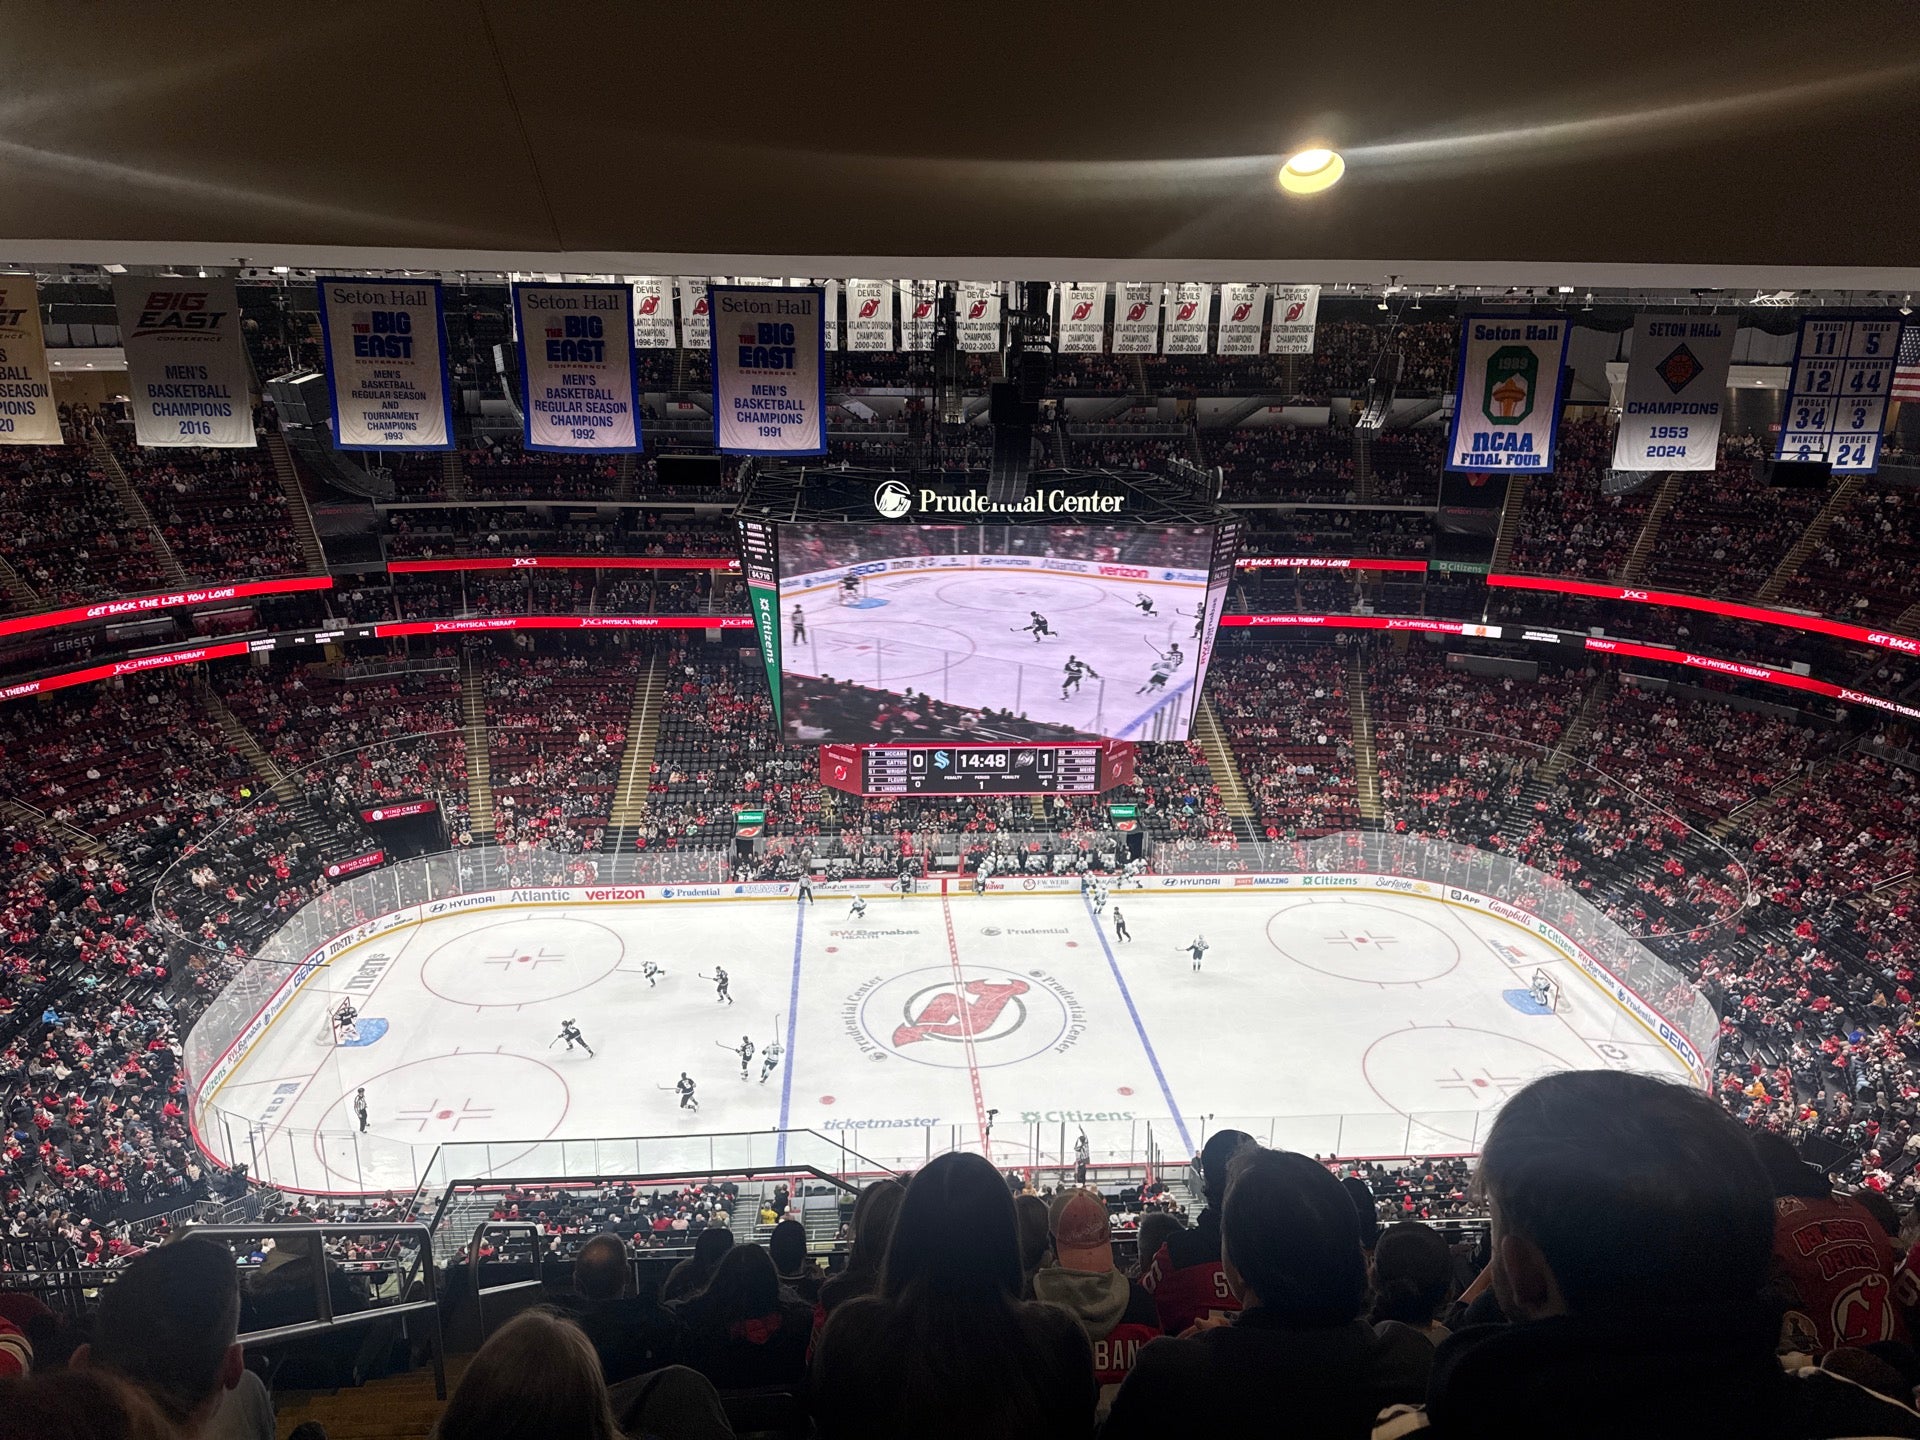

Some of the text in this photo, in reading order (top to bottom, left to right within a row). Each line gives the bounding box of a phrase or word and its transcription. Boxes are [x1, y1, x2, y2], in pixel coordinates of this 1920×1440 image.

[636, 286, 660, 294] DEVILS
[857, 289, 881, 297] DEVILS
[1072, 292, 1095, 300] DEVILS
[1127, 292, 1150, 300] DEVILS
[1178, 292, 1200, 300] DEVILS
[145, 293, 208, 310] BIG
[333, 288, 428, 305] Seton Hall
[527, 294, 619, 310] Seton Hall
[722, 297, 811, 315] Seton Hall
[137, 312, 226, 328] EAST
[372, 311, 412, 334] BIG
[849, 321, 871, 329] ATLANTIC
[545, 316, 604, 338] THE BIG
[637, 329, 666, 337] CHAMPIONS
[1061, 324, 1082, 332] ATLANTIC
[1115, 324, 1136, 332] ATLANTIC
[1167, 324, 1187, 332] ATLANTIC
[1221, 325, 1241, 333] ATLANTIC
[1475, 324, 1558, 340] Seton Hall
[1649, 323, 1721, 337] SETON HALL
[1813, 323, 1843, 331] DAVIES
[758, 322, 795, 345] BIG
[856, 332, 884, 340] CHAMPIONS
[964, 333, 991, 341] CHAMPIONS
[1068, 334, 1095, 342] CHAMPIONS
[1122, 334, 1149, 343] CHAMPIONS
[1172, 335, 1199, 343] CHAMPIONS
[1227, 335, 1252, 343] CHAMPIONS
[1276, 335, 1308, 343] CHAMPIONS
[353, 335, 412, 358] EAST
[635, 339, 669, 347] 1996-1997
[854, 341, 887, 349] 2000-2001
[960, 342, 996, 350] 2002-2003
[1118, 344, 1152, 352] 2006-2007
[1815, 333, 1836, 354] 11
[1866, 333, 1880, 354] 5
[546, 339, 605, 362] EAST
[739, 346, 796, 369] EAST
[166, 365, 208, 379] MEN'S
[374, 370, 401, 379] MEN'S
[361, 381, 415, 390] BASKETBALL
[562, 374, 596, 385] MEN'S
[1807, 371, 1832, 392] 12
[1850, 370, 1882, 392] 44
[148, 385, 231, 399] BASKETBALL
[352, 391, 426, 400] REGULAR SEASON
[546, 388, 614, 400] BASKETBALL
[752, 385, 787, 396] MEN'S
[382, 401, 399, 409] AND
[535, 400, 627, 413] REGULAR SEASON
[734, 397, 805, 411] BASKETBALL
[1627, 402, 1719, 414] CHAMPIONS
[1797, 399, 1830, 407] MOSLEY
[153, 403, 232, 417] CHAMPIONS
[363, 412, 420, 420] TOURNAMENT
[550, 415, 613, 427] CHAMPIONS
[737, 412, 803, 424] CHAMPIONS
[1795, 408, 1826, 429] 34
[1851, 408, 1866, 429] 3
[180, 421, 210, 434] 2016
[367, 422, 417, 430] CHAMPIONS
[758, 426, 781, 437] 1991
[384, 432, 404, 440] 1993
[571, 429, 595, 439] 1992
[1650, 427, 1689, 438] 1953
[1839, 436, 1872, 444] DEHERE
[1646, 446, 1686, 457] 2024
[1836, 444, 1866, 465] 24
[1506, 454, 1541, 466] FOUR
[1048, 489, 1125, 513] Center
[512, 557, 538, 567] JAG
[1041, 557, 1088, 573] Atlantic
[1251, 558, 1271, 566] BACK
[1290, 558, 1309, 566] LIFE
[1310, 559, 1326, 567] YOU
[1327, 559, 1350, 567] LOVE!
[1448, 563, 1482, 573] Citizens
[1098, 564, 1149, 579] verizon
[1620, 589, 1648, 600] JAG
[86, 588, 235, 617] GET BACK THE LIFE YOU LOVE!
[456, 619, 517, 628] PHYSICAL THERAPY
[1408, 620, 1437, 629] PHYSICAL
[52, 634, 96, 653] JERSEY
[761, 612, 774, 664] Citizens
[1867, 633, 1916, 651] GET BACK
[1585, 639, 1616, 650] THERAPY
[137, 650, 206, 667] PHYSICAL THERAPY
[1707, 659, 1771, 678] PHYSICAL THERAPY
[5, 682, 40, 697] THERAPY
[1838, 689, 1897, 711] JAG PHYSICAL
[912, 754, 923, 768] 0
[960, 754, 1006, 768] 14:48
[1042, 753, 1049, 767] 1
[914, 780, 921, 788] 0
[979, 781, 984, 790] 1
[1041, 779, 1048, 787] 4
[383, 808, 401, 816] WIND
[401, 804, 422, 812] CREEK
[340, 855, 379, 871] WIND CREEK
[1253, 877, 1289, 885] AMAZING
[1314, 876, 1358, 885] Citizens
[1375, 876, 1412, 889] Surfside
[510, 889, 571, 903] Atlantic
[585, 887, 645, 901] verizon
[677, 888, 720, 897] Prudential
[449, 895, 496, 909] HYUNDAI
[1007, 927, 1069, 935] Prudential
[1547, 929, 1577, 957] Citizens
[293, 950, 325, 988] GEICO
[270, 987, 293, 1016] Prudential
[1625, 994, 1657, 1028] Prudential
[1659, 1022, 1697, 1067] GEICO
[1044, 1110, 1134, 1123] Citizens
[823, 1116, 940, 1130] ticketmaster
[1817, 1245, 1880, 1280] DEVILS
